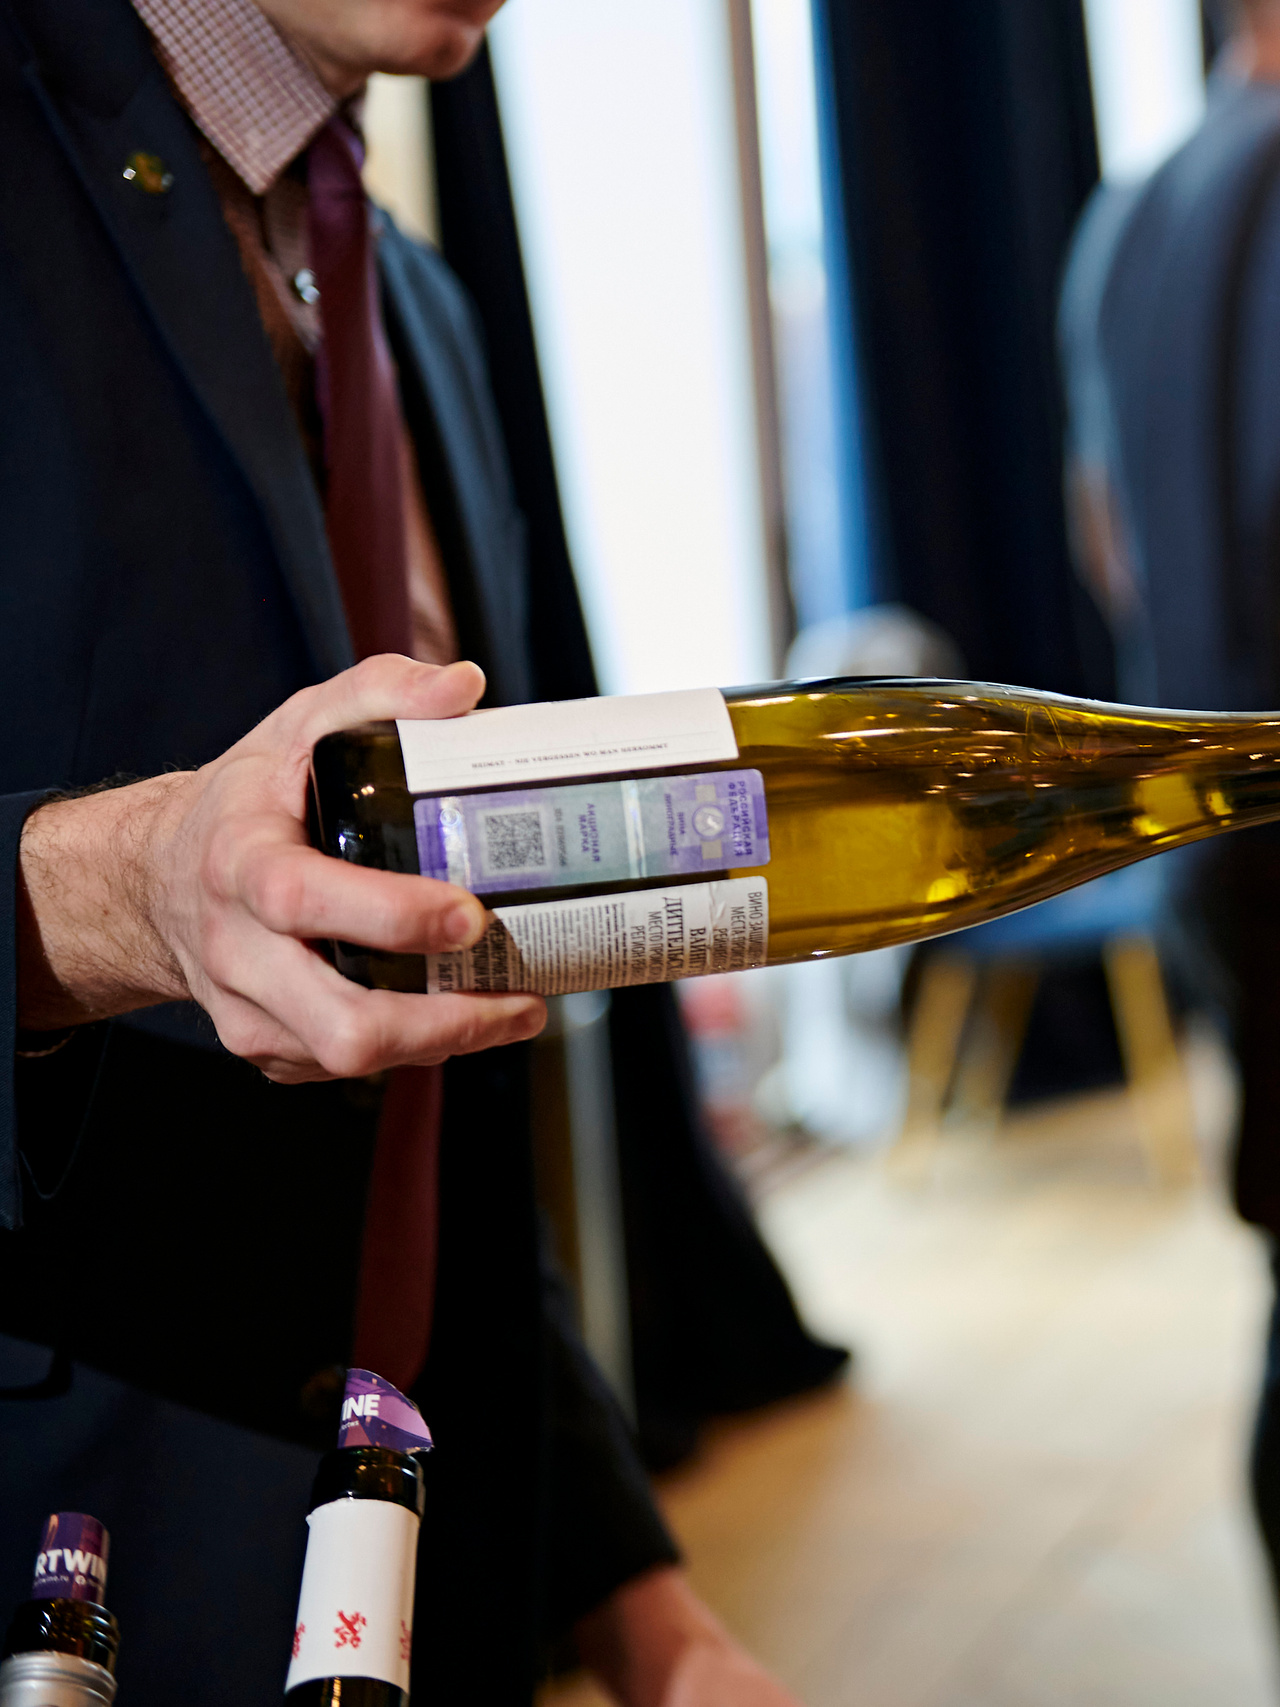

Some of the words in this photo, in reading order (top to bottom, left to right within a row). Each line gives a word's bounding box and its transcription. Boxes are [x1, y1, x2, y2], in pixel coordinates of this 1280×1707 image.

[577, 814, 589, 853] МАРКА
[586, 802, 601, 862] АКЦИЗНАЯ
[727, 782, 744, 857] ФЕДЕРАЦИЯ
[737, 781, 753, 856] РОССИЙСКАЯ
[730, 906, 746, 936] МЕСТА
[747, 891, 763, 920] ВИНО
[629, 925, 646, 961] РЕГИОН
[647, 911, 663, 943] МЕСТО
